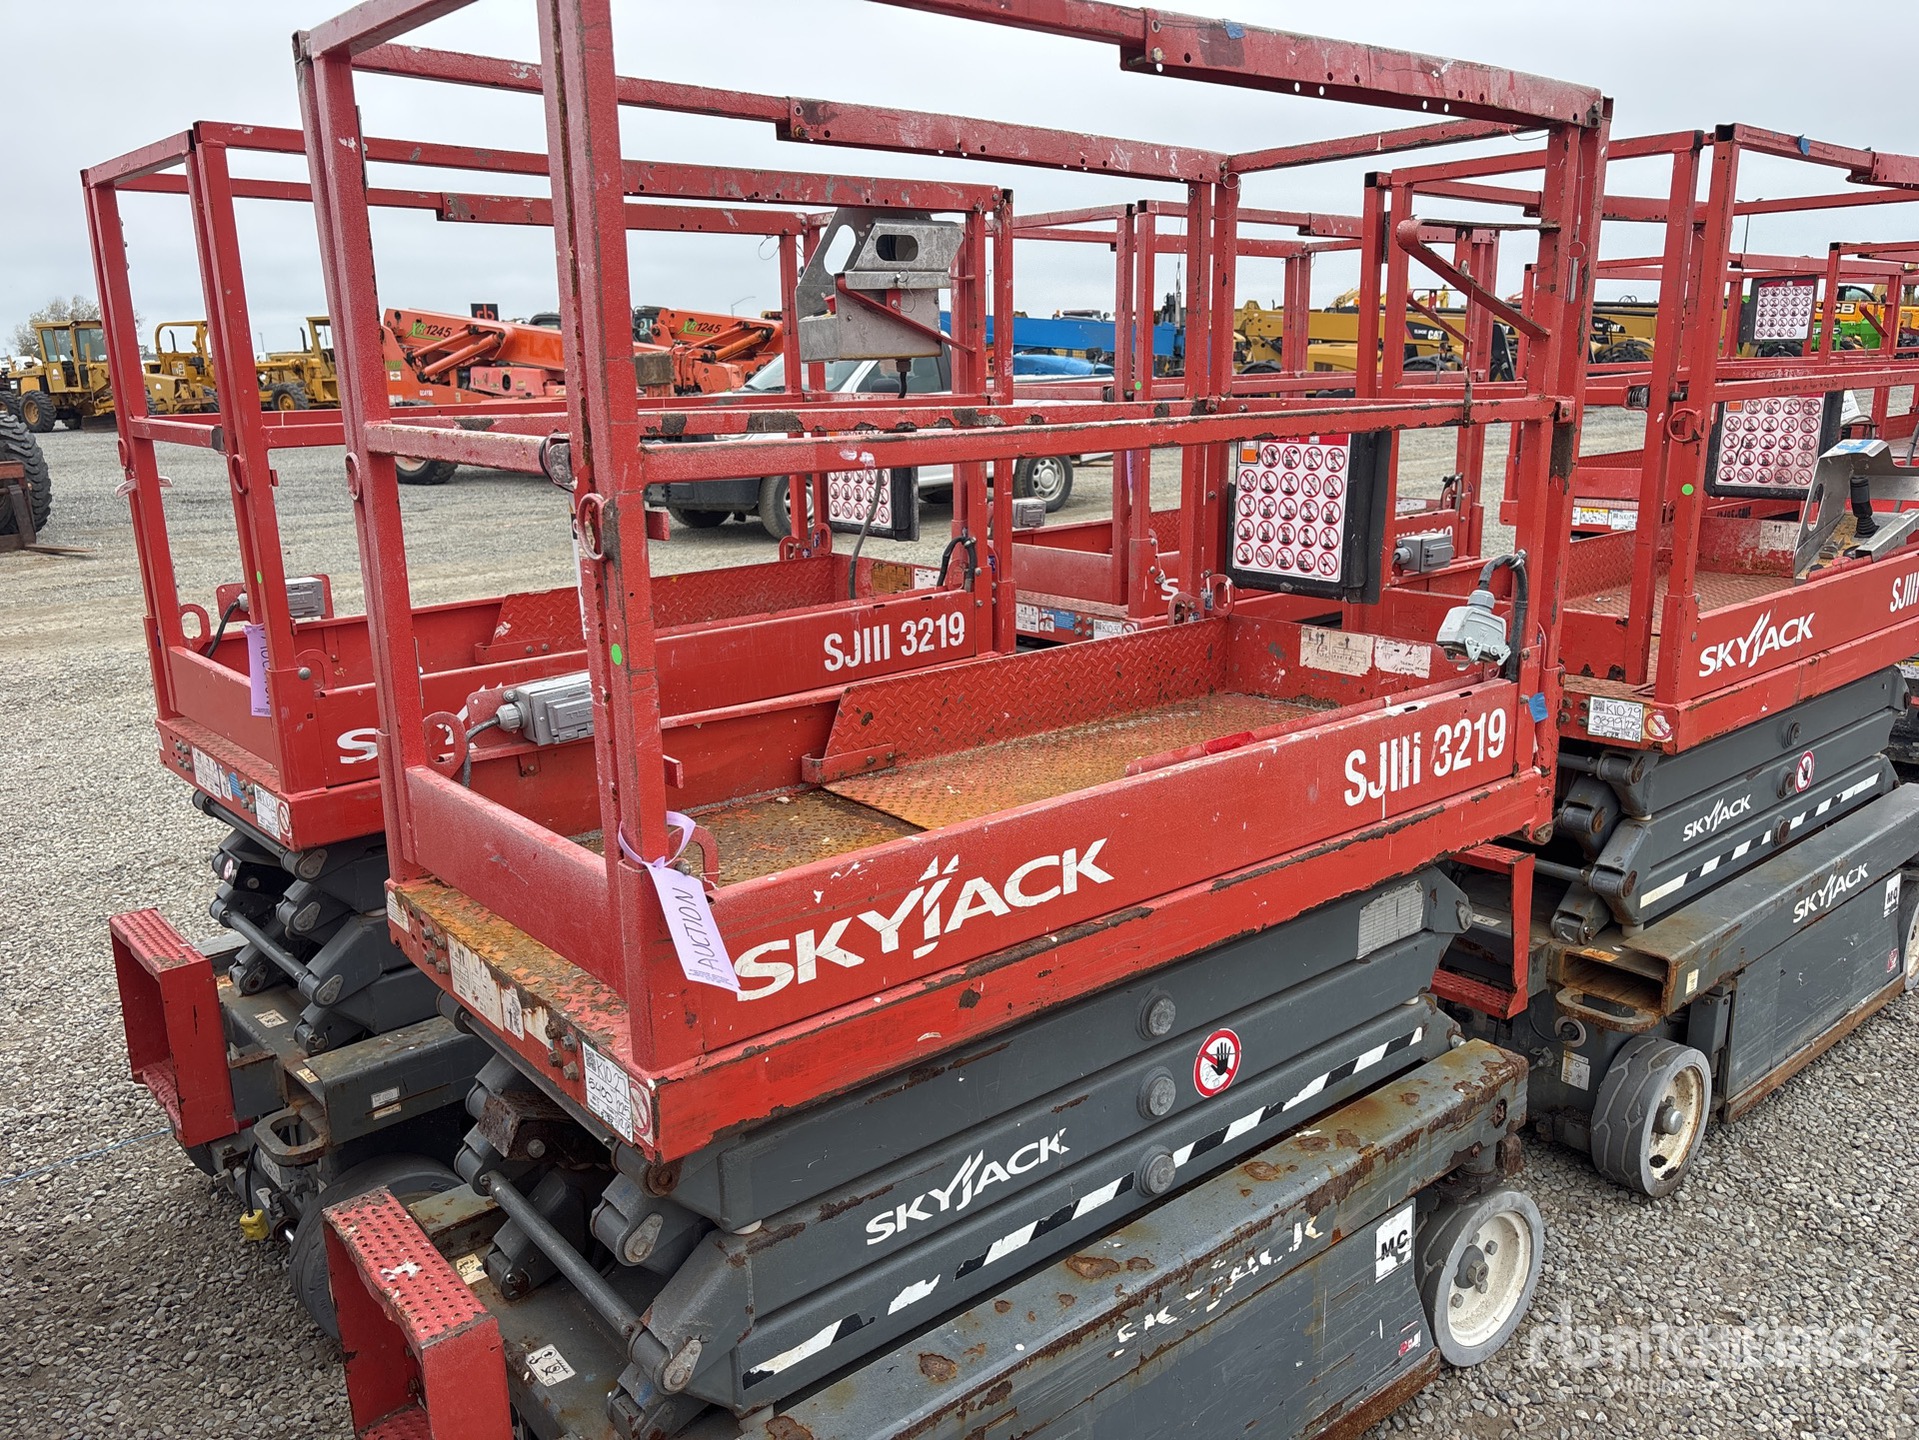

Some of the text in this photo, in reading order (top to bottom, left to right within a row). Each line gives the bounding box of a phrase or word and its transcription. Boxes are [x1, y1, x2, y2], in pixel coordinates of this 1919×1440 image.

[426, 324, 452, 338] 1245
[697, 322, 722, 334] 1245
[1427, 330, 1444, 340] CAT
[900, 611, 966, 656] 3219
[1698, 609, 1816, 677] SKYJACK
[1433, 707, 1507, 777] 3219
[1682, 793, 1752, 842] SKYJACK
[733, 837, 1115, 1002] SKYJACK
[1792, 862, 1870, 924] SKYJACK
[672, 887, 724, 973] AUCTION
[865, 1127, 1071, 1246] SKYJACK
